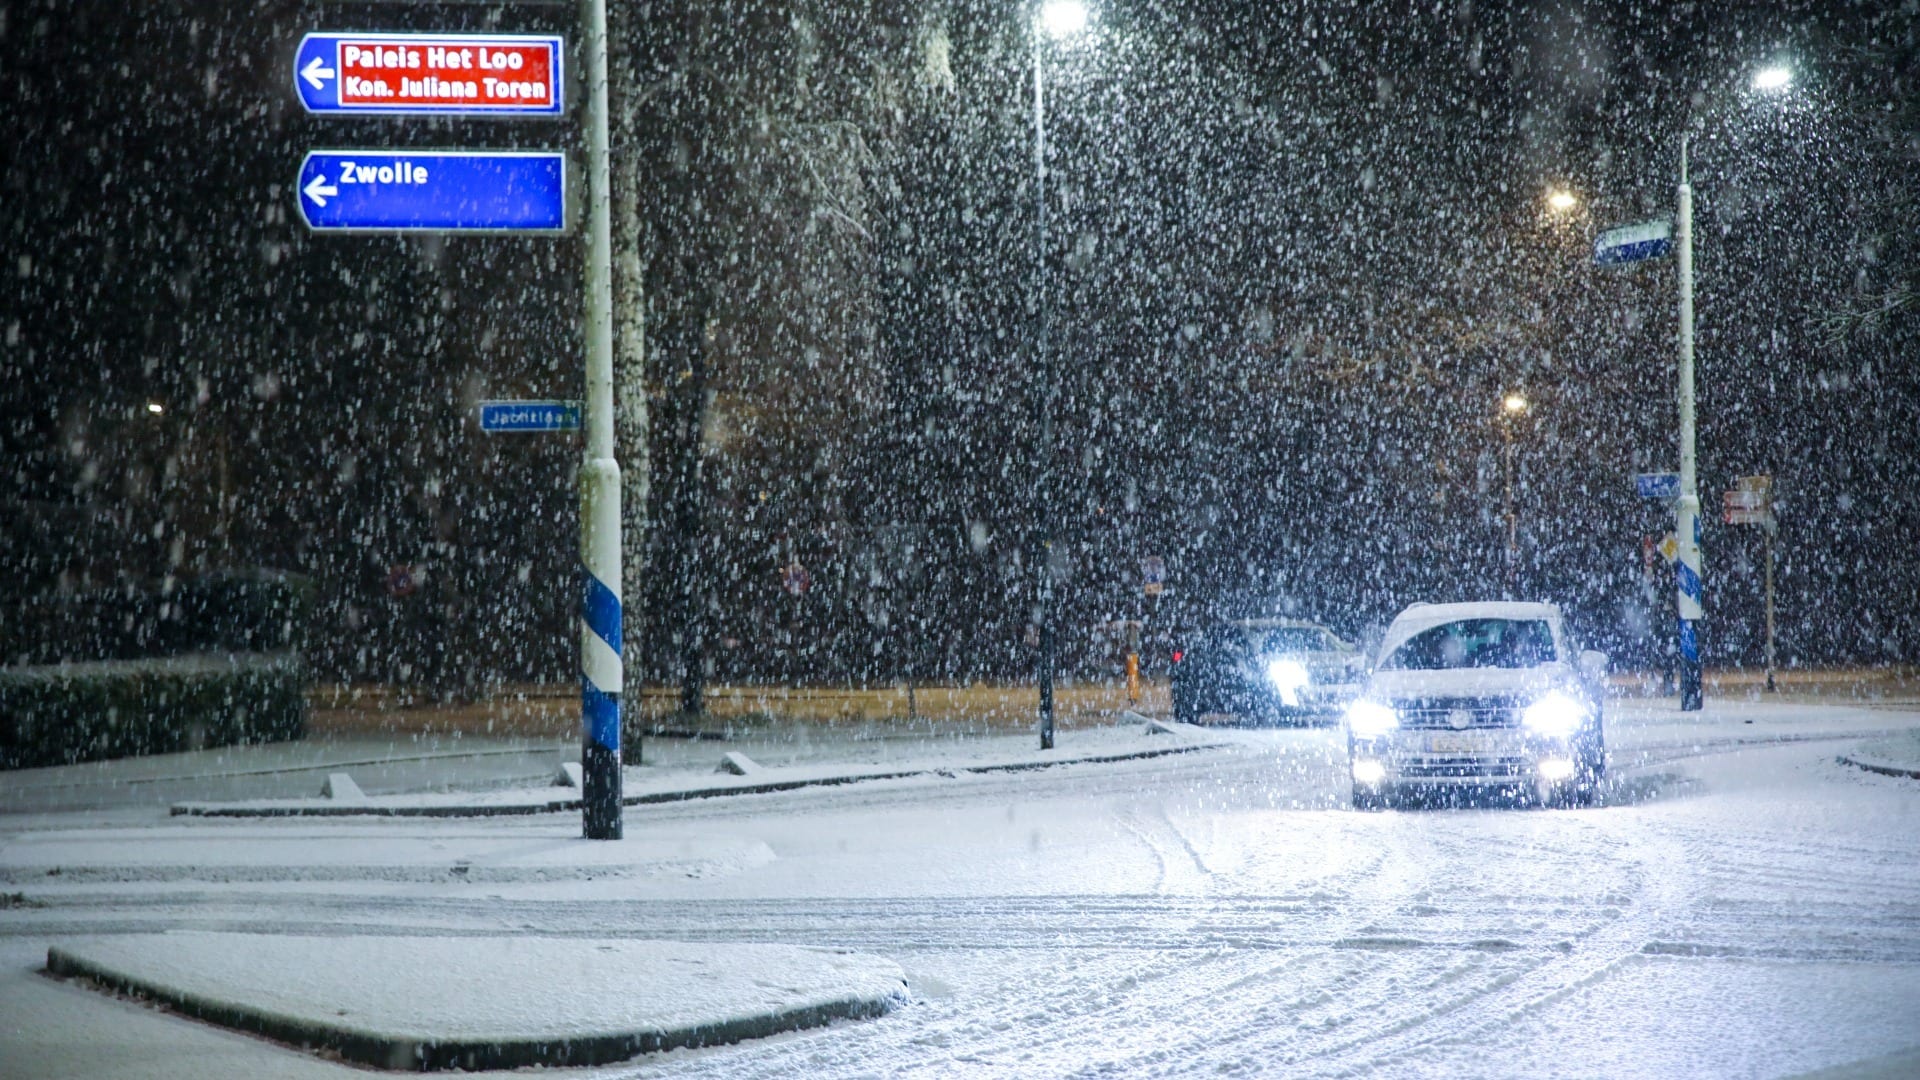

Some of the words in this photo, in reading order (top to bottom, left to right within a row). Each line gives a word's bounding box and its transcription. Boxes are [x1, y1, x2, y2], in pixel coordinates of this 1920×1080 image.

[345, 47, 420, 68] Paleis
[428, 48, 471, 68] Het
[480, 49, 523, 69] Loo
[346, 77, 393, 97] Kon.
[399, 78, 477, 98] Juliana
[483, 79, 546, 99] Toren
[340, 161, 428, 183] Zwolle
